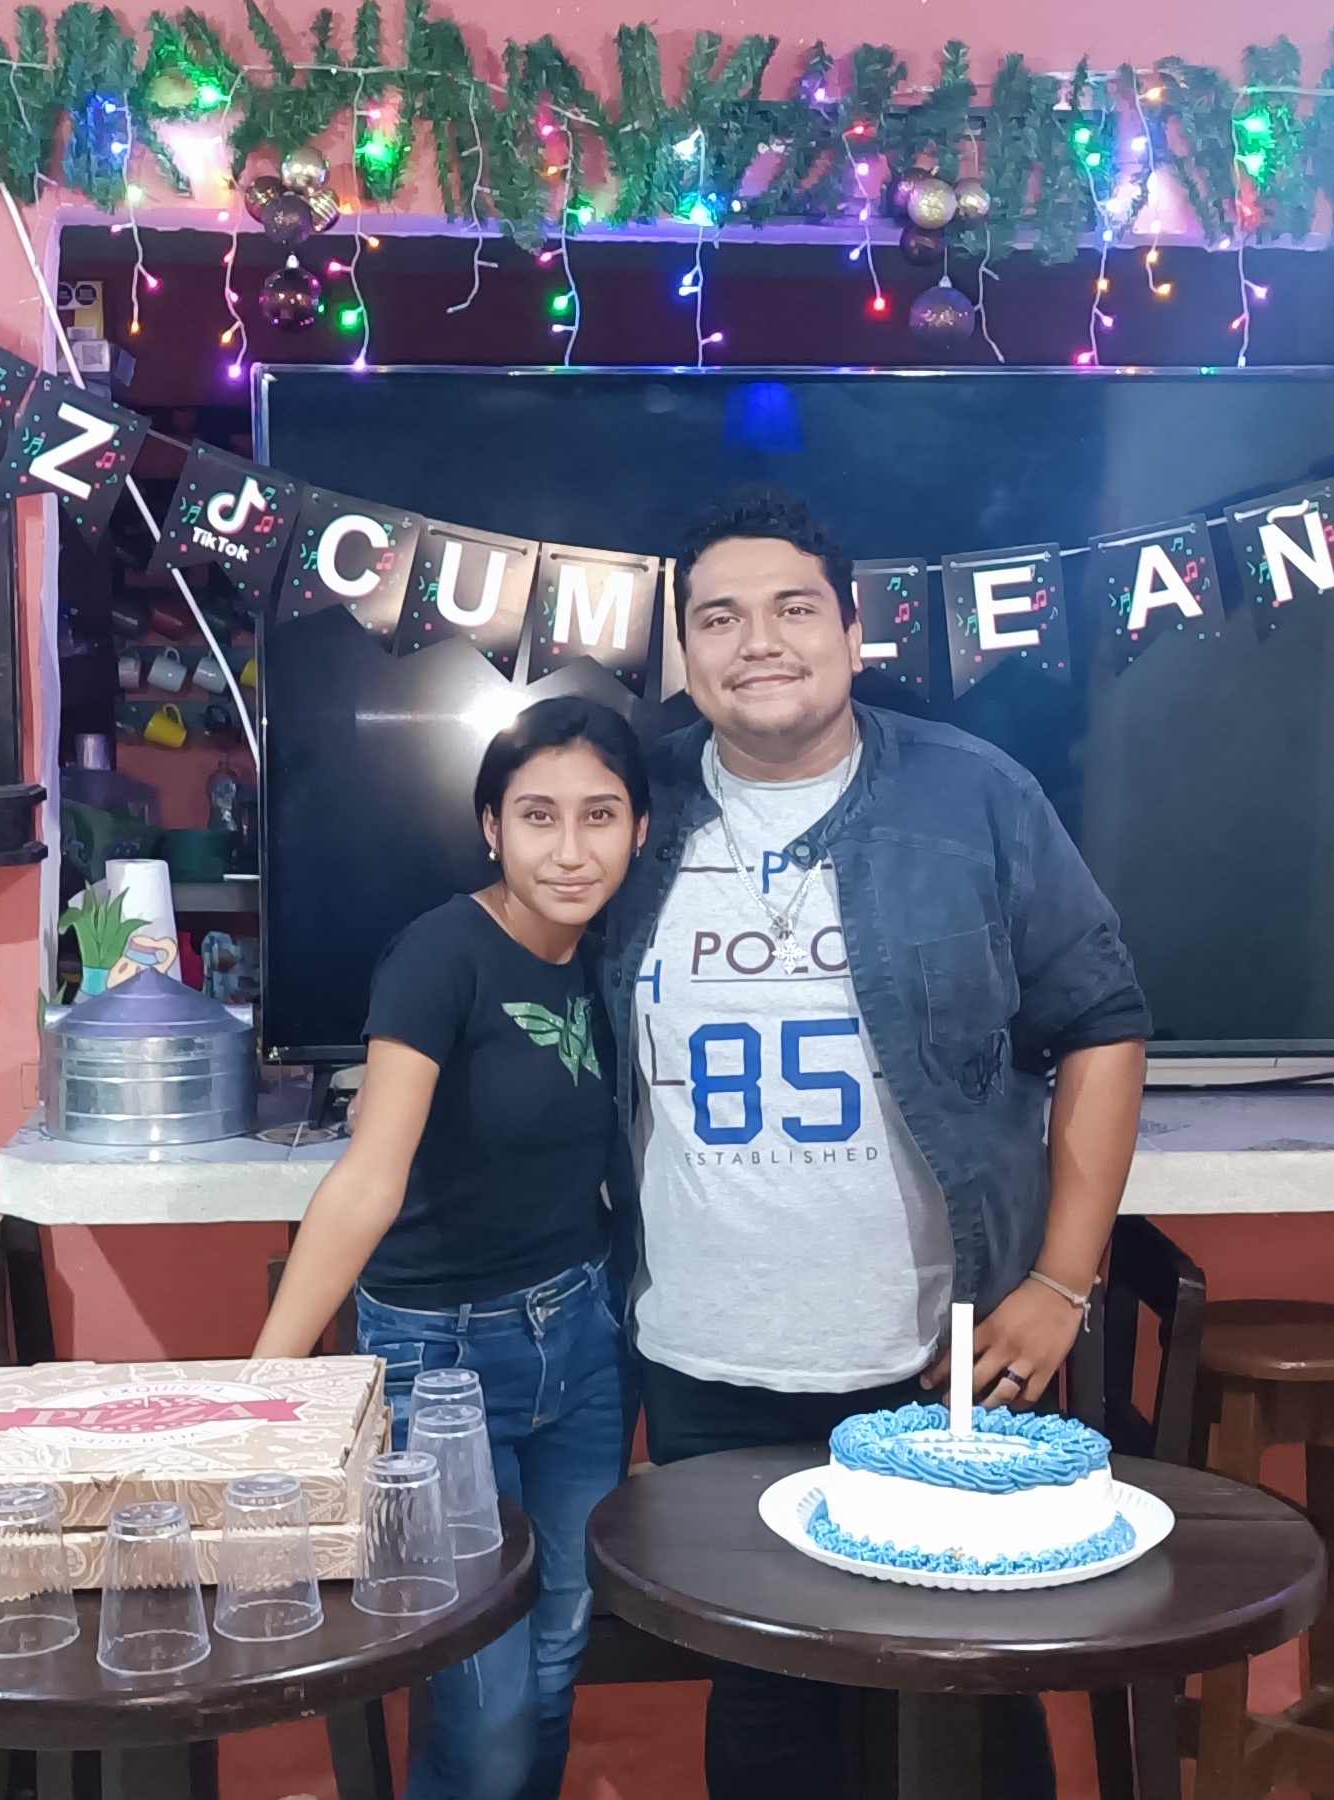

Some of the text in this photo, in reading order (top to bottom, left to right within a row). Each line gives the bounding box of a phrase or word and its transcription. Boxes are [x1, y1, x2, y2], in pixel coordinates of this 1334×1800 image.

[192, 526, 250, 563] TikTok
[689, 1017, 861, 1146] 85
[685, 1146, 878, 1168] ESTABLISHED
[31, 1402, 255, 1426] PIZZA
